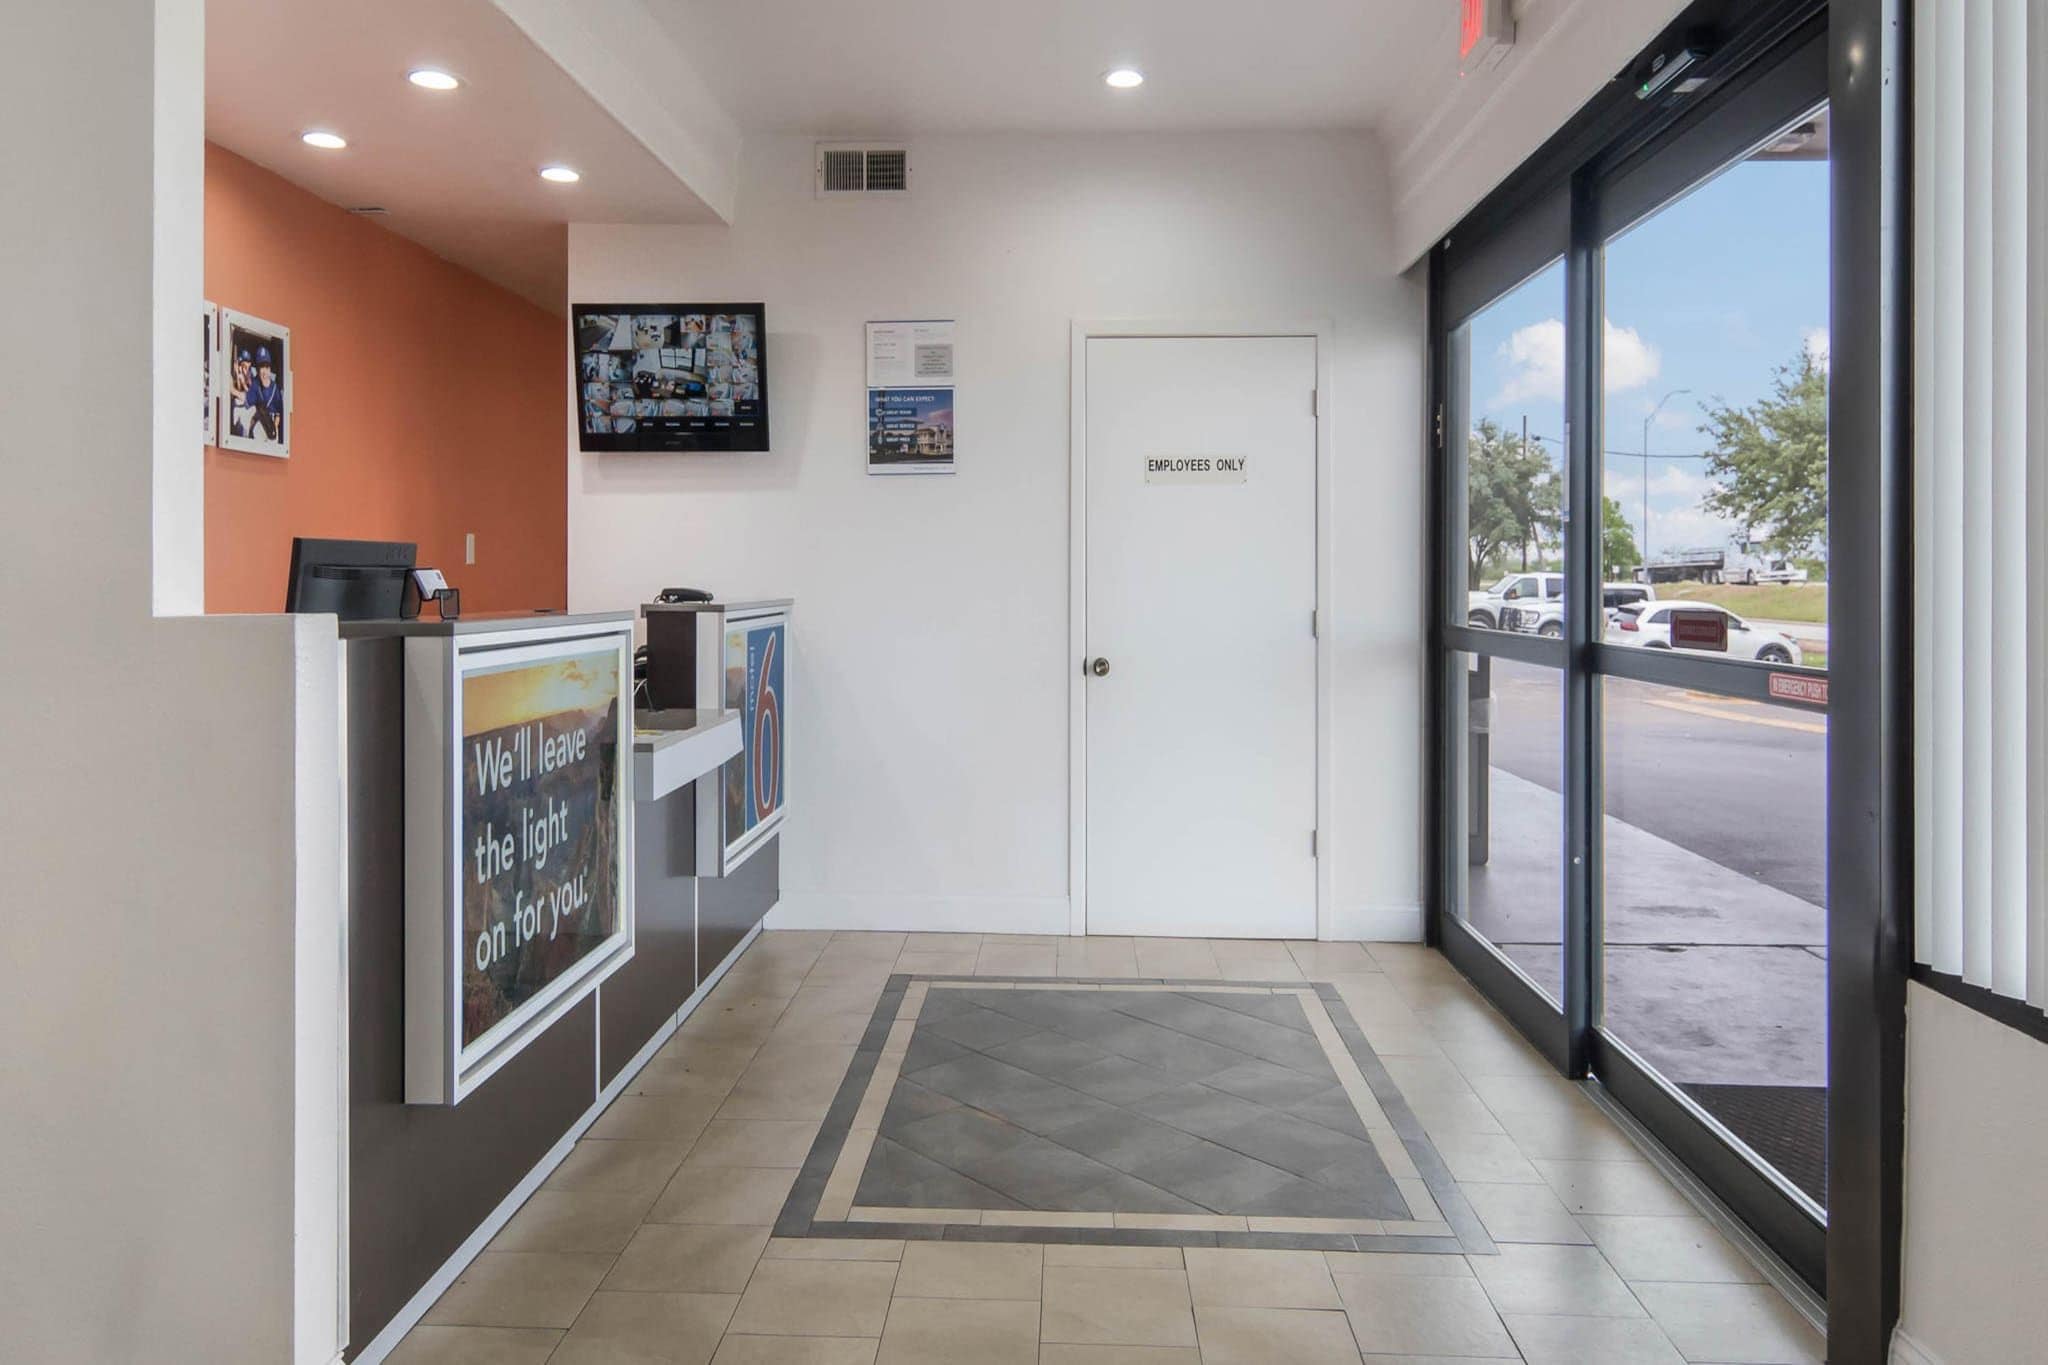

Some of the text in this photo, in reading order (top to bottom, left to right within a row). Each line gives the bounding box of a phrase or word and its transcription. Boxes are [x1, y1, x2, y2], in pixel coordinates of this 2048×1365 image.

[1148, 458, 1245, 472] EMPLOYEES ONLY
[475, 722, 587, 796] We'll leave
[753, 631, 779, 822] 6
[475, 797, 569, 885] the light
[475, 921, 506, 971] on
[513, 890, 544, 947] for
